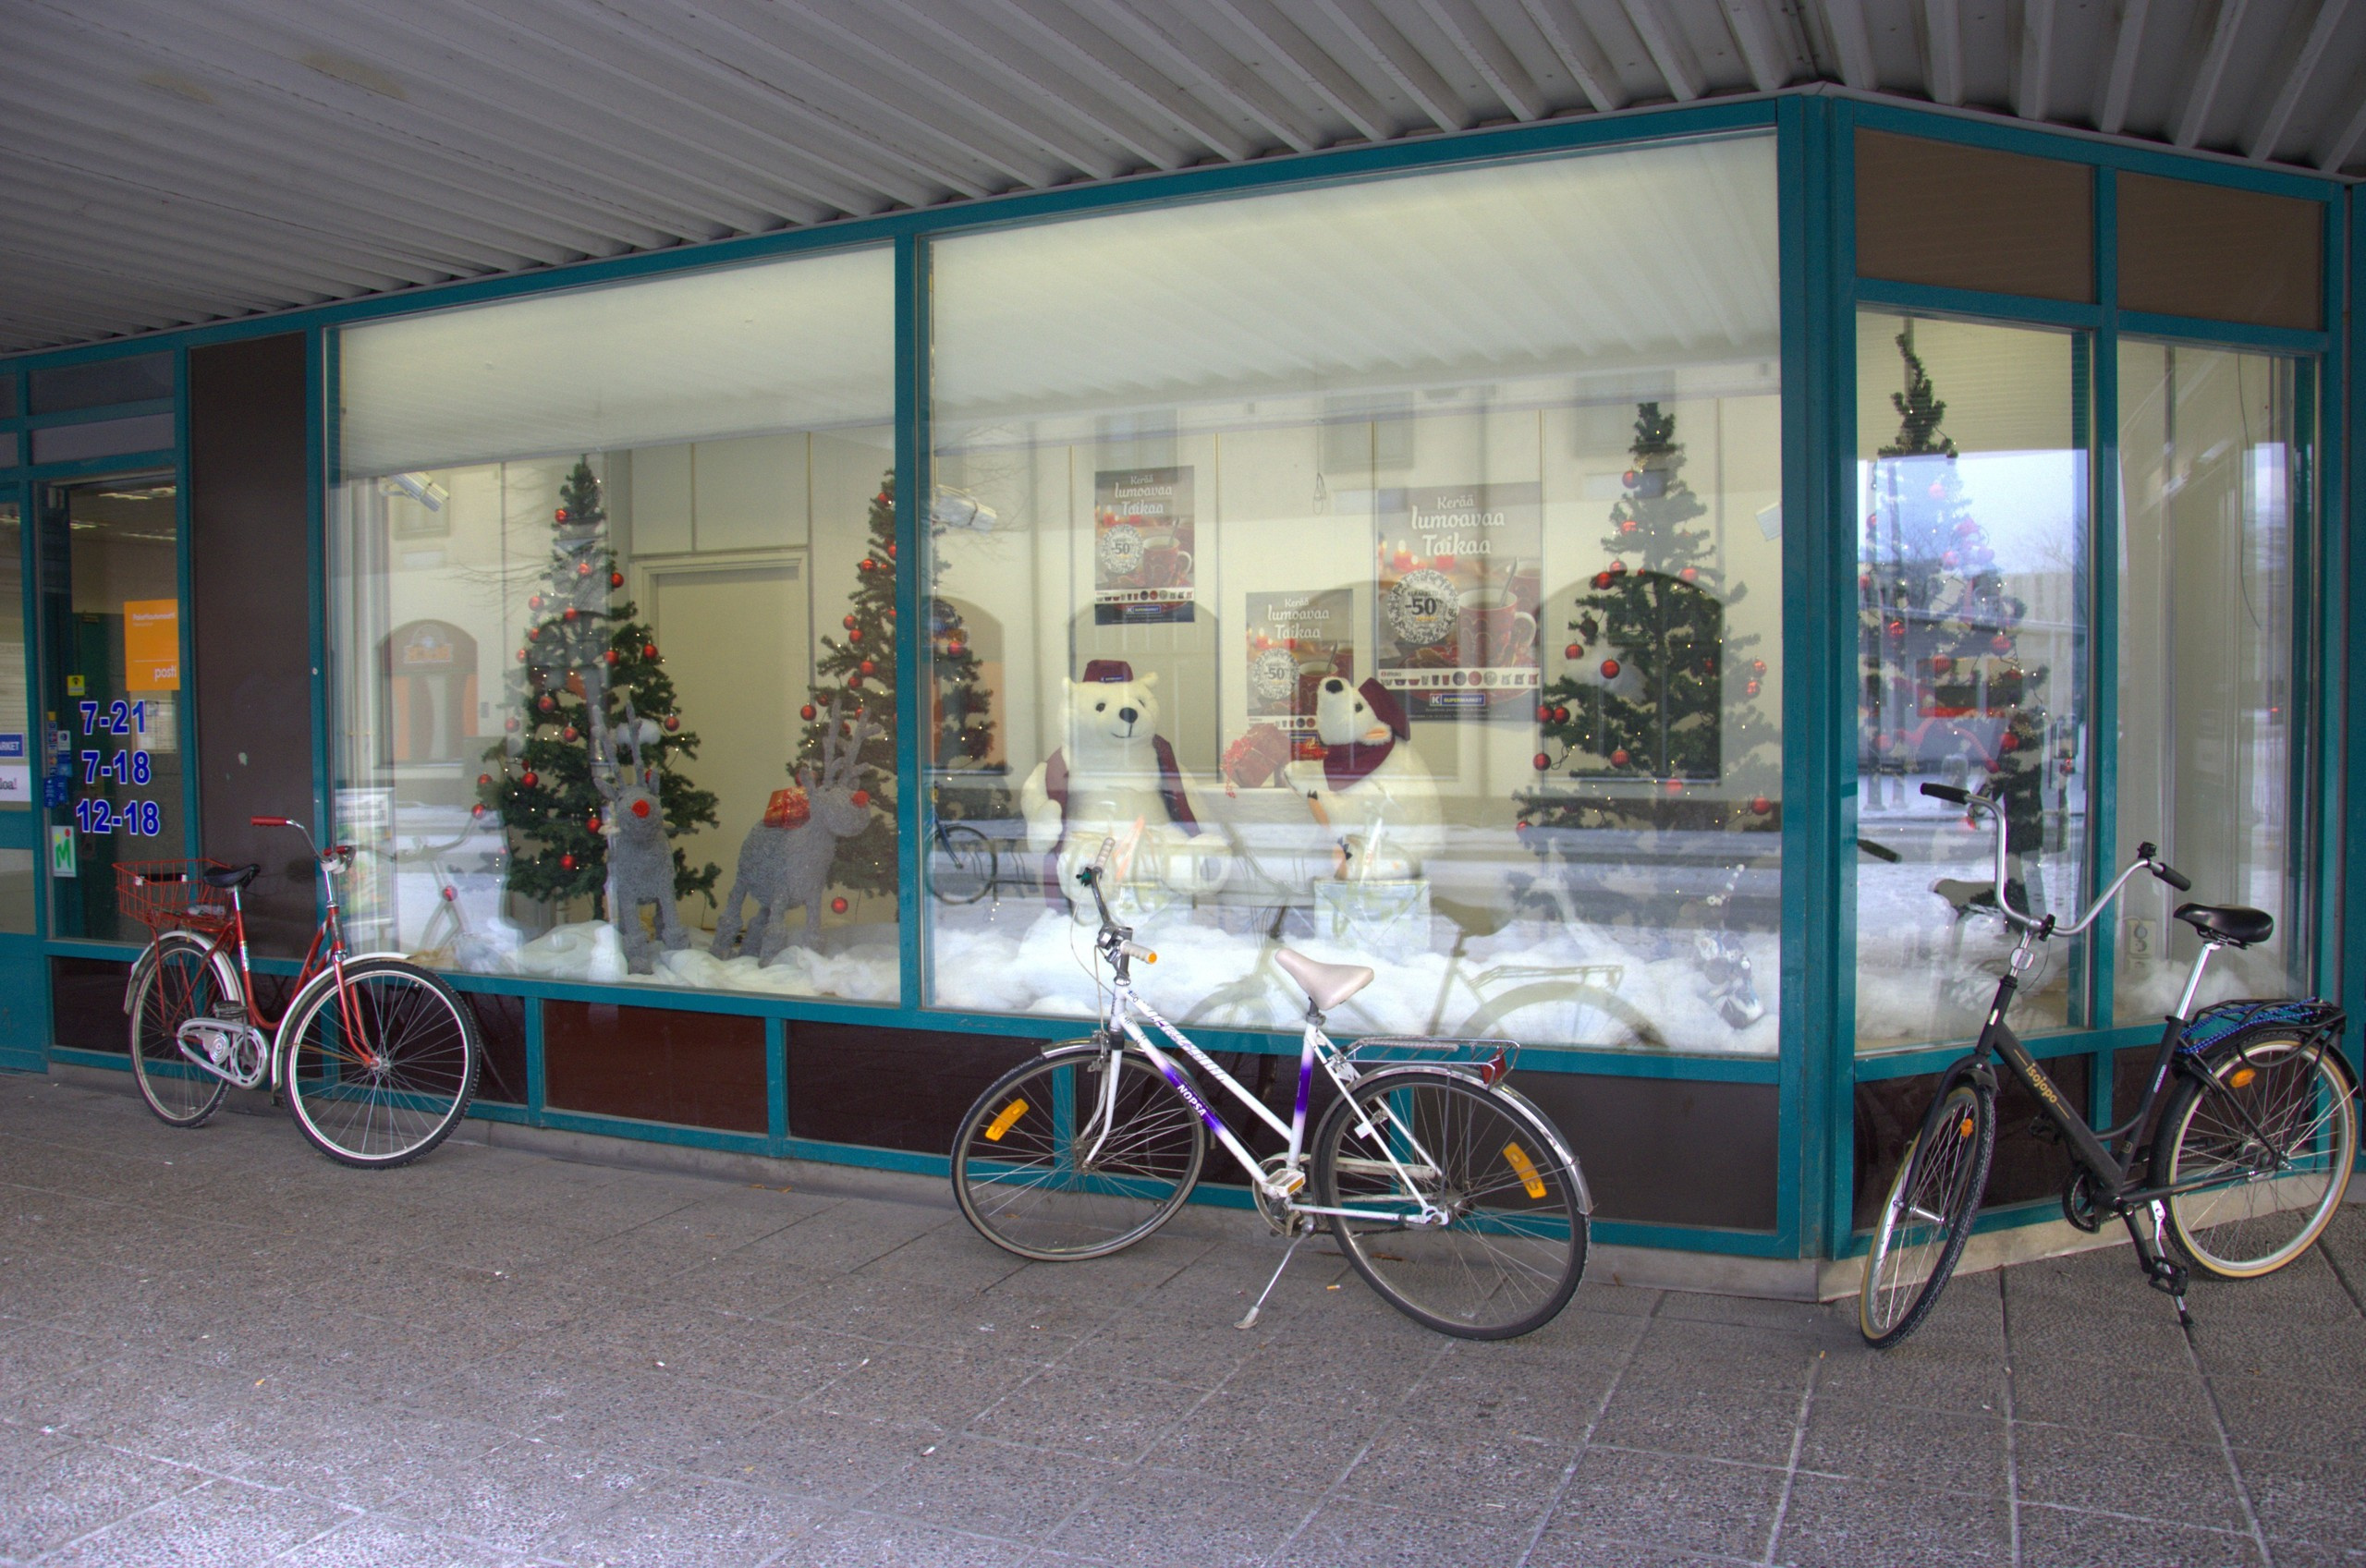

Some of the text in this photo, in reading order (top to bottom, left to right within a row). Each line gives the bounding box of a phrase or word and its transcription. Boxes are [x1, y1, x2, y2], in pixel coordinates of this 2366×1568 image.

[1130, 474, 1153, 485] Kerää
[1115, 481, 1173, 498] lumoavaa
[1121, 499, 1165, 516] Taikaa
[1437, 494, 1474, 509] Kerää
[1411, 505, 1505, 529] lumoavaa
[1421, 532, 1492, 556] Taikaa
[1285, 597, 1309, 608] Kerää
[1267, 604, 1329, 621] lumoavaa
[1274, 624, 1321, 639] Taikaa
[154, 665, 177, 682] posti
[80, 699, 145, 735] 7-21
[81, 749, 151, 784] 7-18
[76, 798, 160, 836] 12-18
[2026, 1063, 2057, 1103] isojopo
[1177, 1084, 1207, 1117] NOPSA
